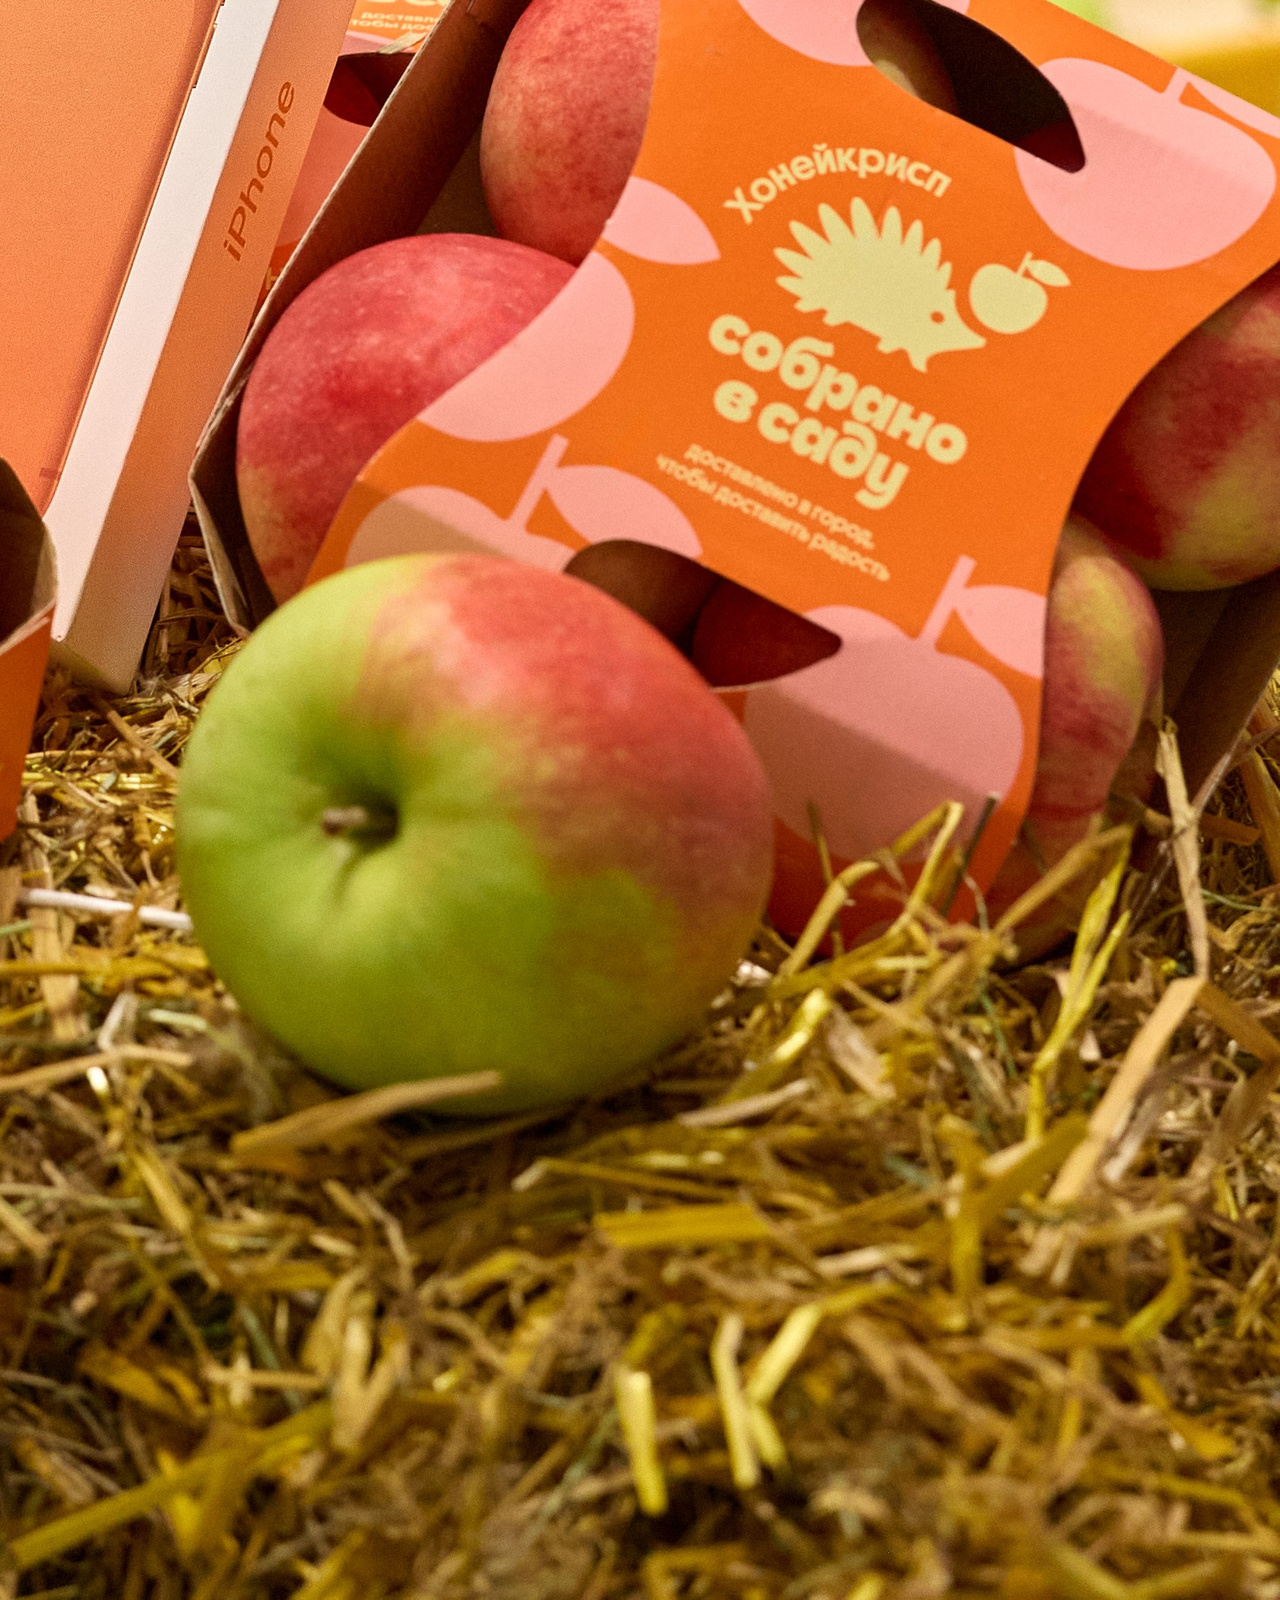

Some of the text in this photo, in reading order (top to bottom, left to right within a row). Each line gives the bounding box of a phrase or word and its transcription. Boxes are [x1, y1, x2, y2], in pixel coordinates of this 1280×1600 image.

[349, 17, 399, 29] тобы
[361, 11, 438, 23] доставл
[223, 81, 295, 262] iPhone
[723, 143, 952, 224] Хонейкрисп
[709, 314, 967, 464] собрано
[684, 443, 799, 509] доставлено
[797, 499, 812, 516] в
[713, 379, 909, 510] в саду
[656, 454, 891, 582] чтобы доставить радость
